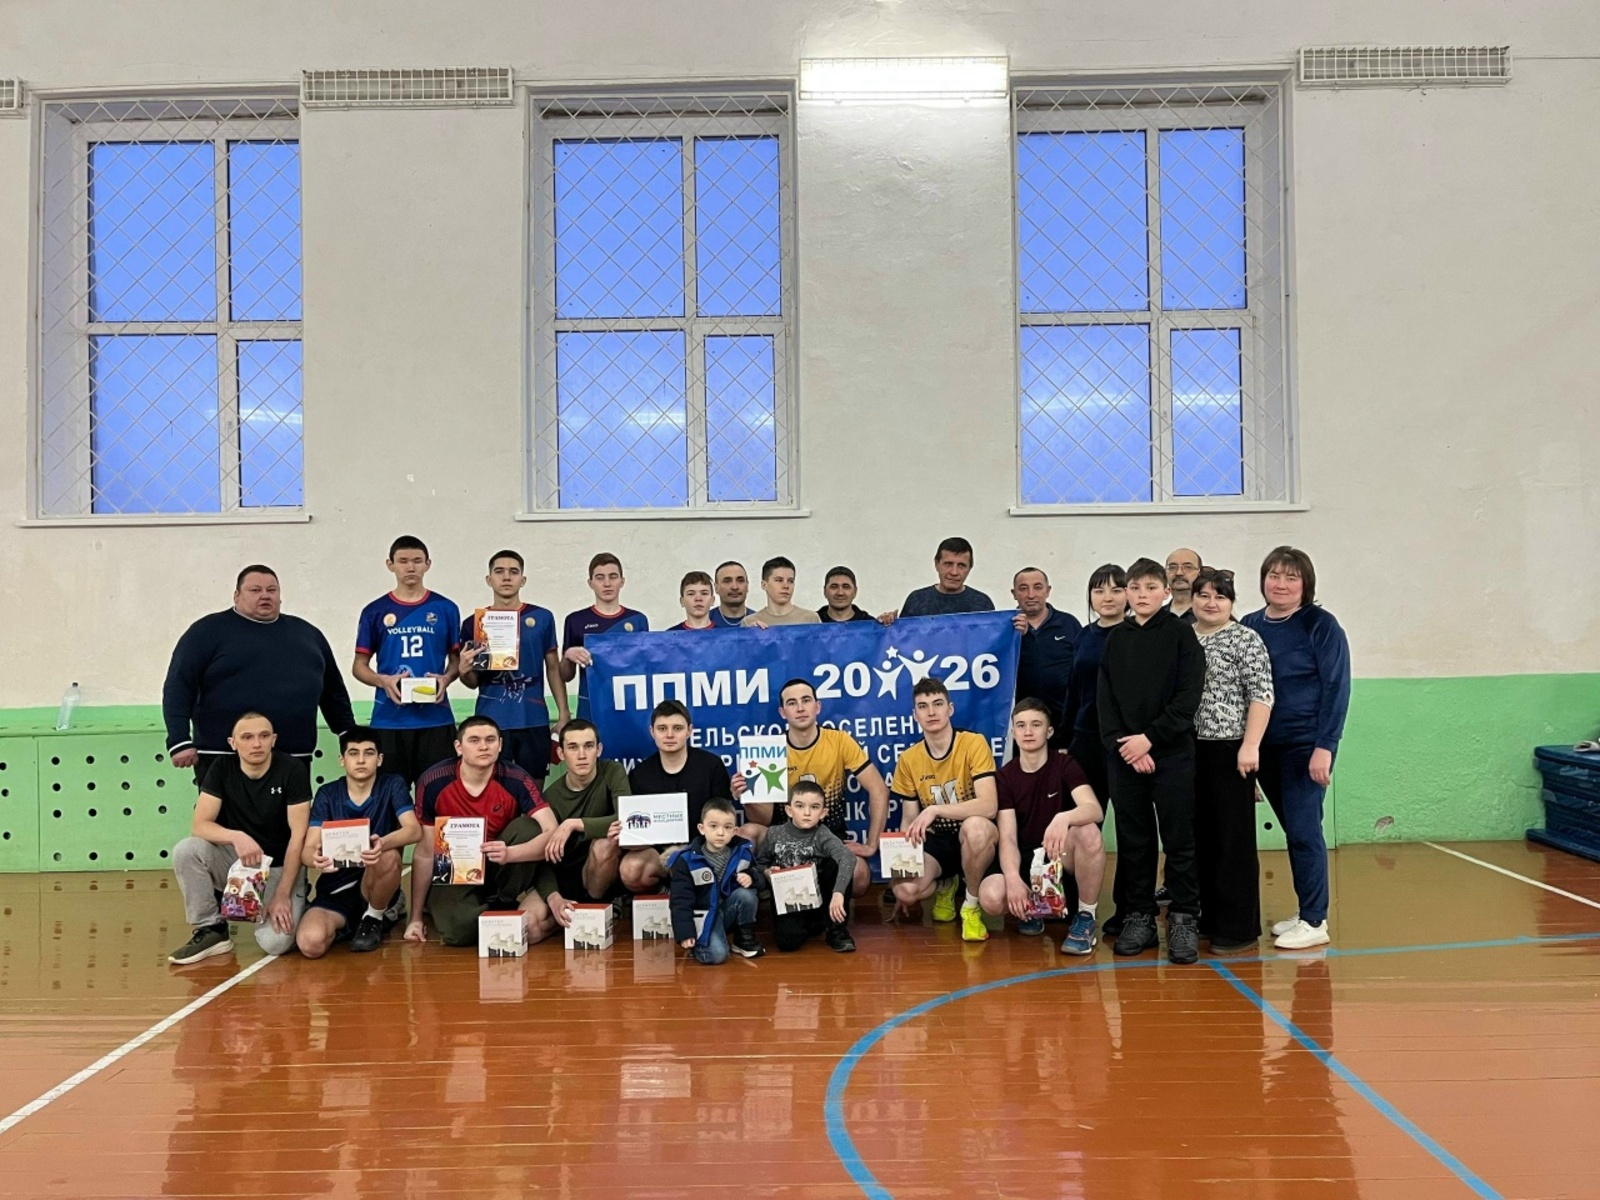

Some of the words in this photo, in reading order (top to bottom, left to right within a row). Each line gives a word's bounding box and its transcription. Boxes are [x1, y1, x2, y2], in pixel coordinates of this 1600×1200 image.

[387, 625, 435, 635] VOLLEYBALL
[400, 635, 424, 658] 12
[612, 668, 770, 711] ППМИ
[690, 723, 790, 748] ЕЛЬСКО
[740, 745, 787, 759] ППМИ
